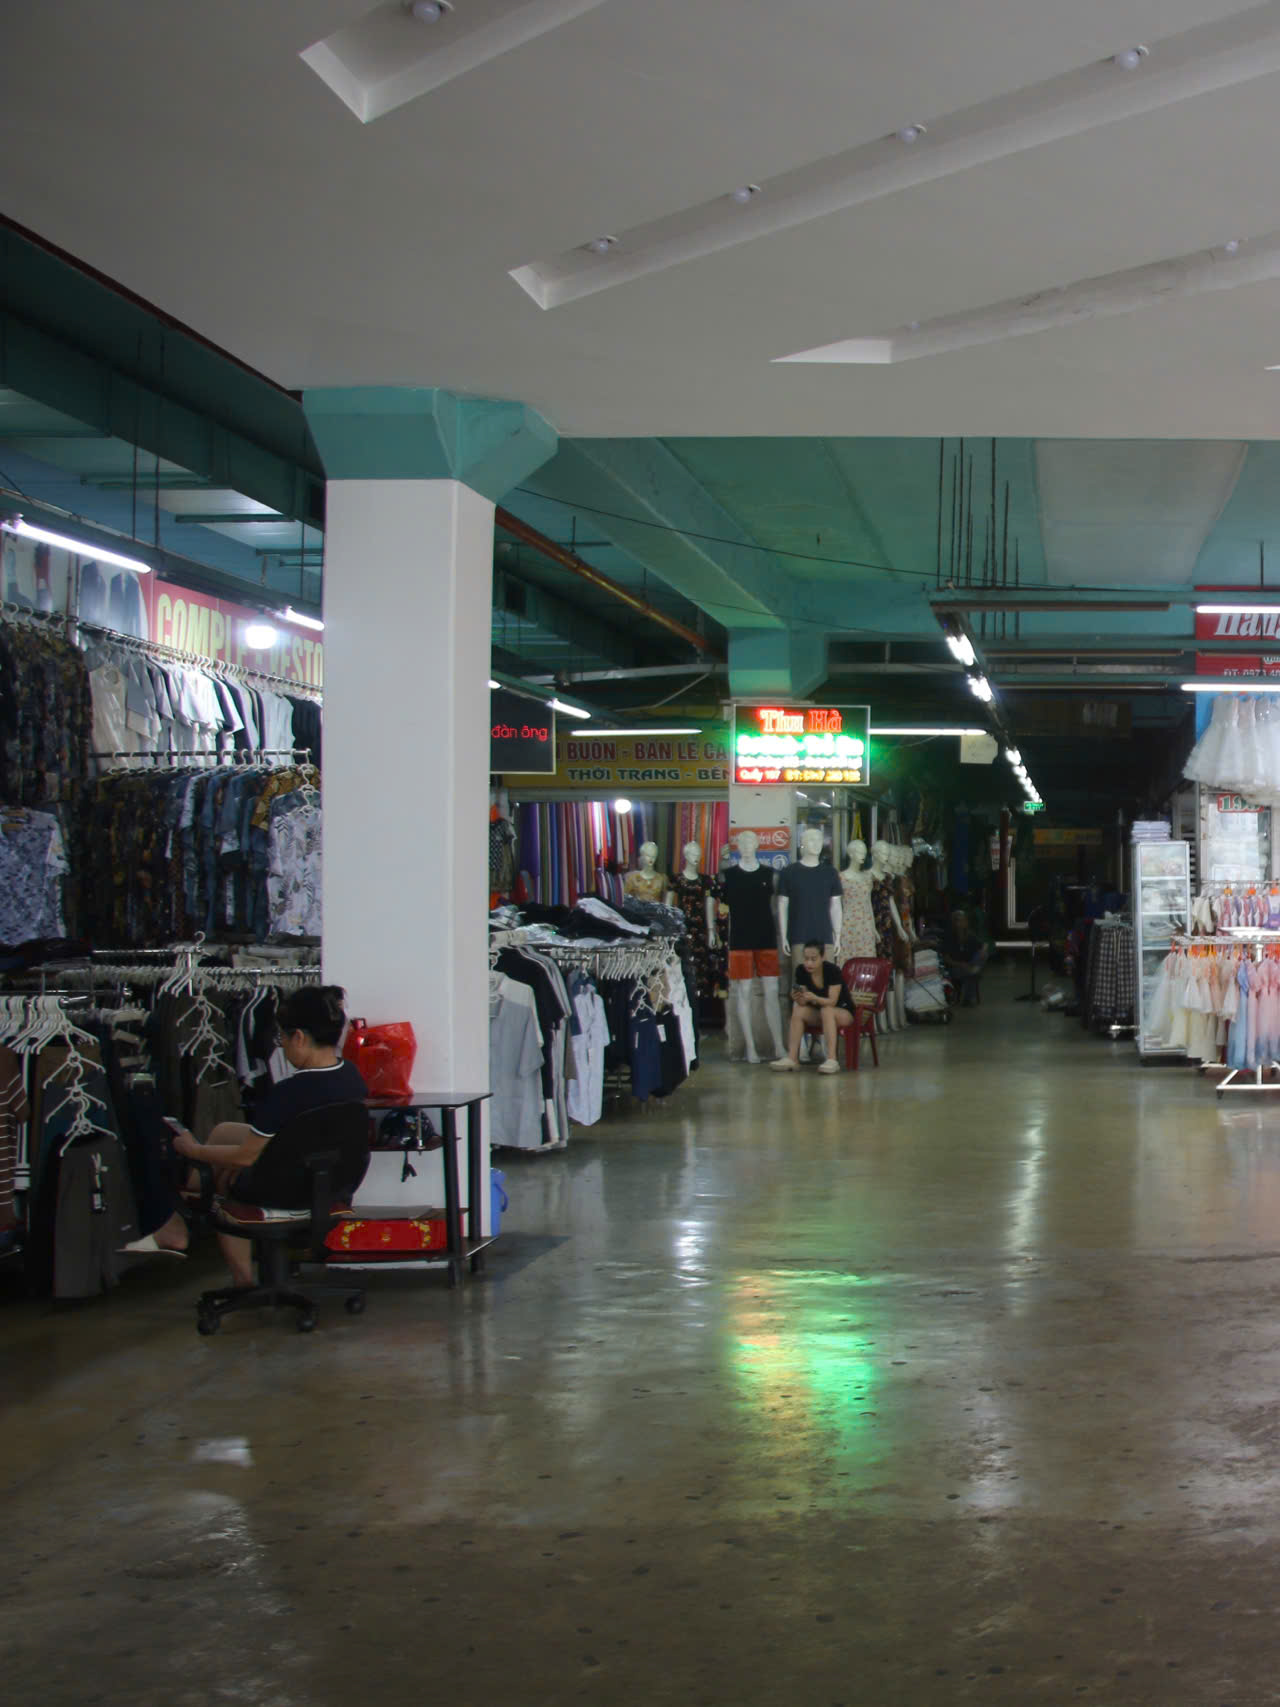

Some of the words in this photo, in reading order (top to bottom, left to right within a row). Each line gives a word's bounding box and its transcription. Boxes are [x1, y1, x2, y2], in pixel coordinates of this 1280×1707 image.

[758, 708, 804, 733] Thu
[808, 708, 843, 733] Hà
[617, 767, 680, 781] TRANG
[1222, 795, 1260, 811] 19
